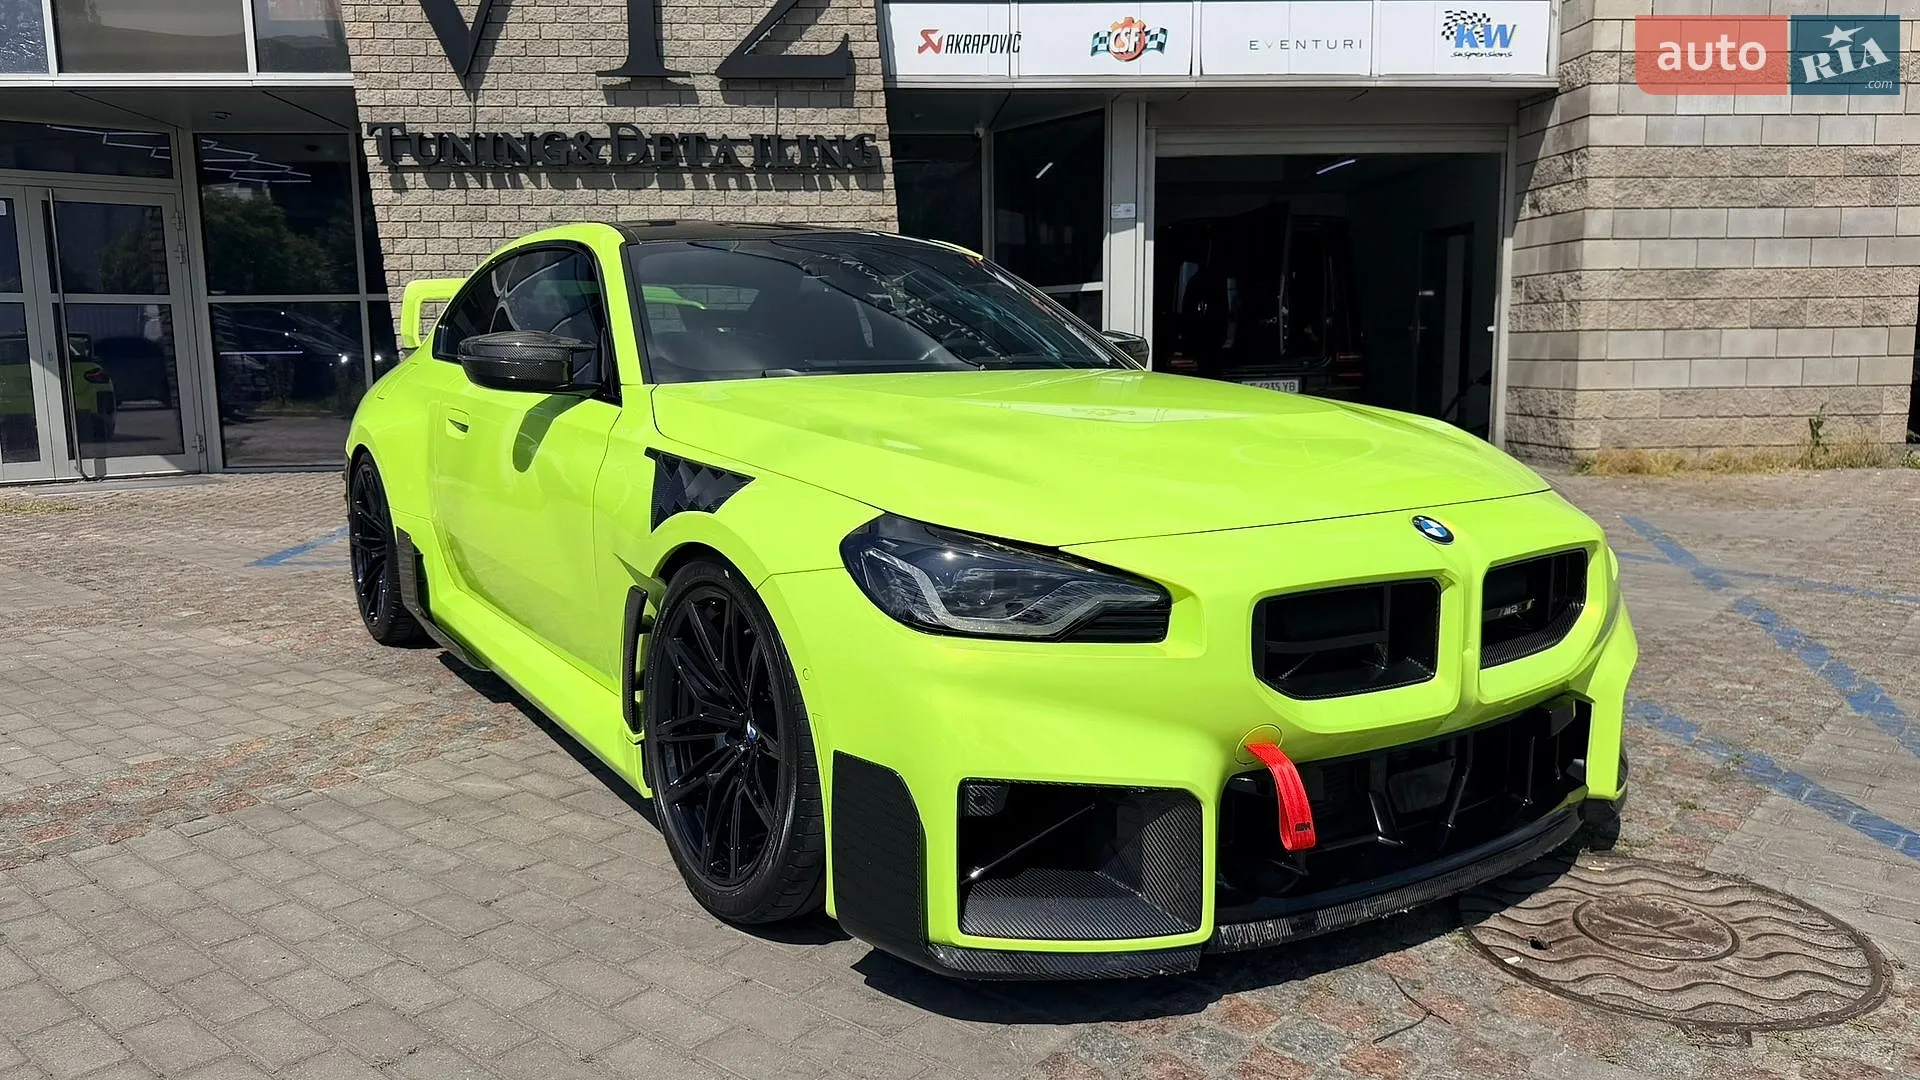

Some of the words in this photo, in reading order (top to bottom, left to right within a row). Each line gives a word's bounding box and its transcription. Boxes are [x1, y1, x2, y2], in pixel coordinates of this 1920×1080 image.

[945, 31, 1022, 54] AKRAPOVIČ
[1110, 27, 1142, 54] CSF
[1249, 38, 1363, 51] EVENTURI
[1454, 23, 1517, 48] KW
